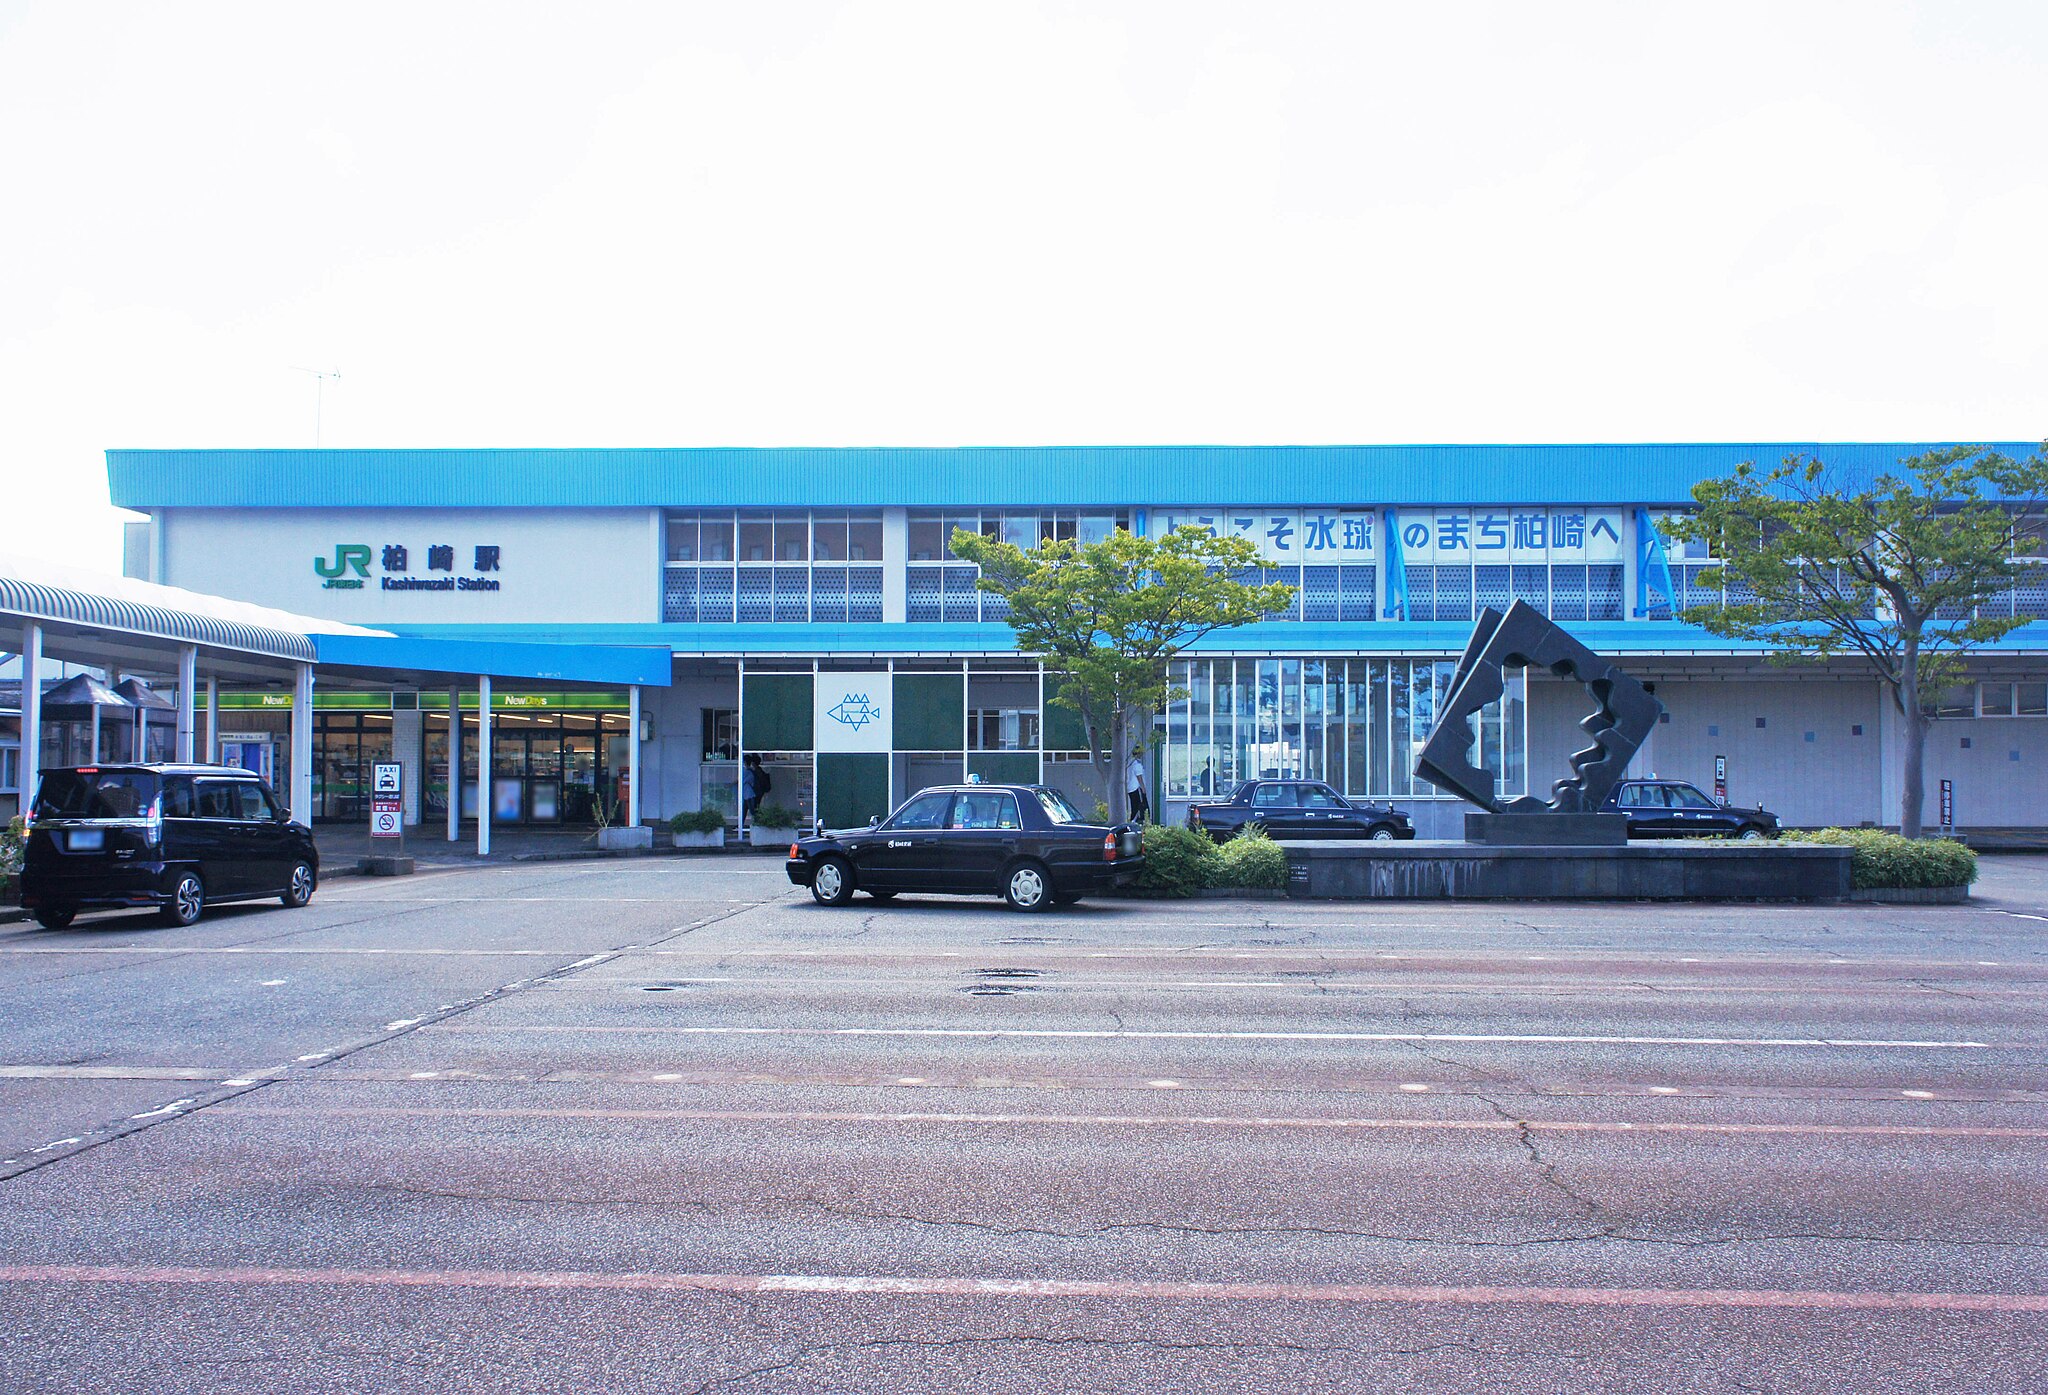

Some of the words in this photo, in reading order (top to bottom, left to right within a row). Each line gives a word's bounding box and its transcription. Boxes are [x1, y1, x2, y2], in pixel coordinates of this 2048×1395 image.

[315, 544, 372, 578] JR
[382, 544, 500, 571] 柏崎駅
[381, 576, 455, 591] Kashiwazaki
[457, 576, 500, 591] Station
[263, 695, 293, 705] NewD
[504, 695, 548, 706] NewDays
